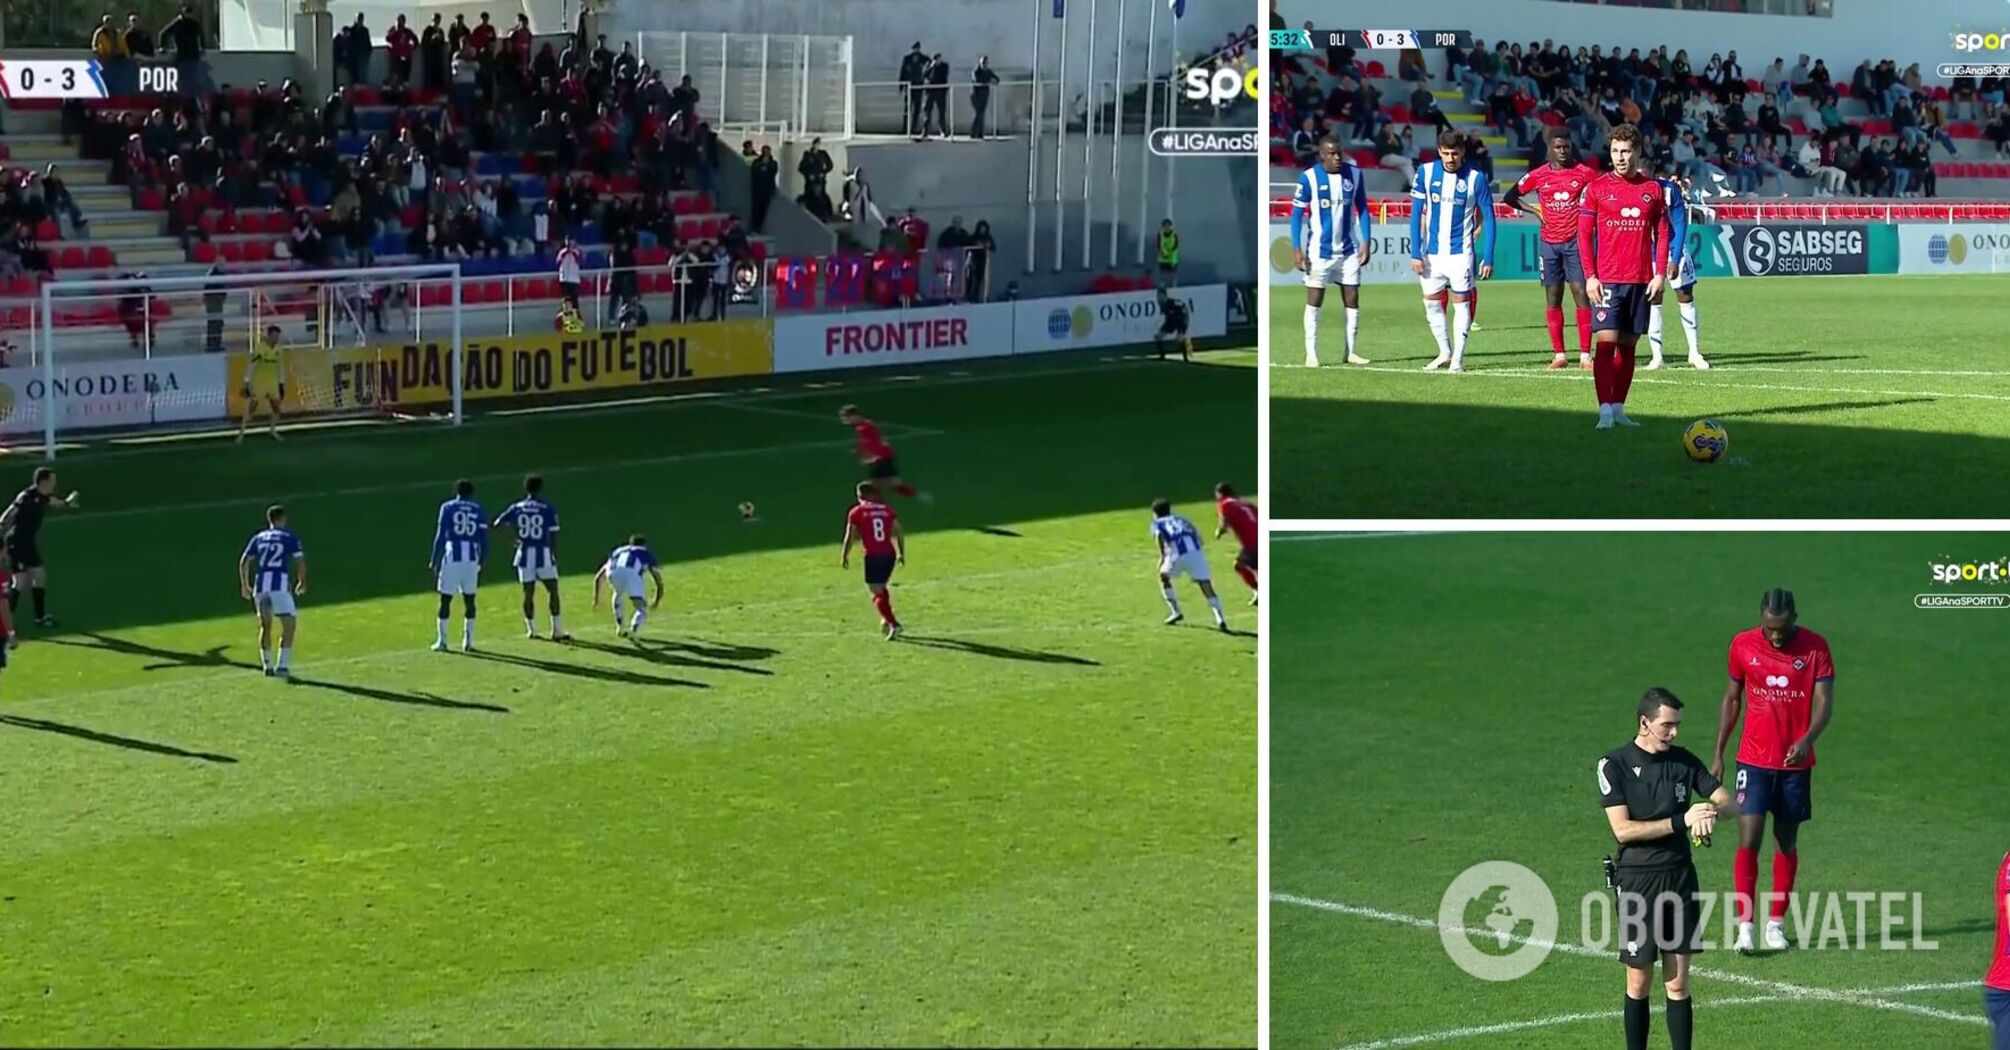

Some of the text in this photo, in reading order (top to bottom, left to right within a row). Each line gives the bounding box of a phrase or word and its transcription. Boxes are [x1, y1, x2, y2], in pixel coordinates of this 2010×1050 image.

[1778, 230, 1863, 255] SABSEG
[1778, 256, 1833, 272] SEGUROS
[825, 318, 968, 356] FRONTIER
[512, 347, 552, 392] DO
[561, 329, 693, 383] FUTEBOL
[26, 372, 179, 400] ONODERA
[453, 511, 478, 536] 95
[518, 513, 543, 540] 98
[873, 518, 886, 541] 8
[257, 543, 284, 568] 72
